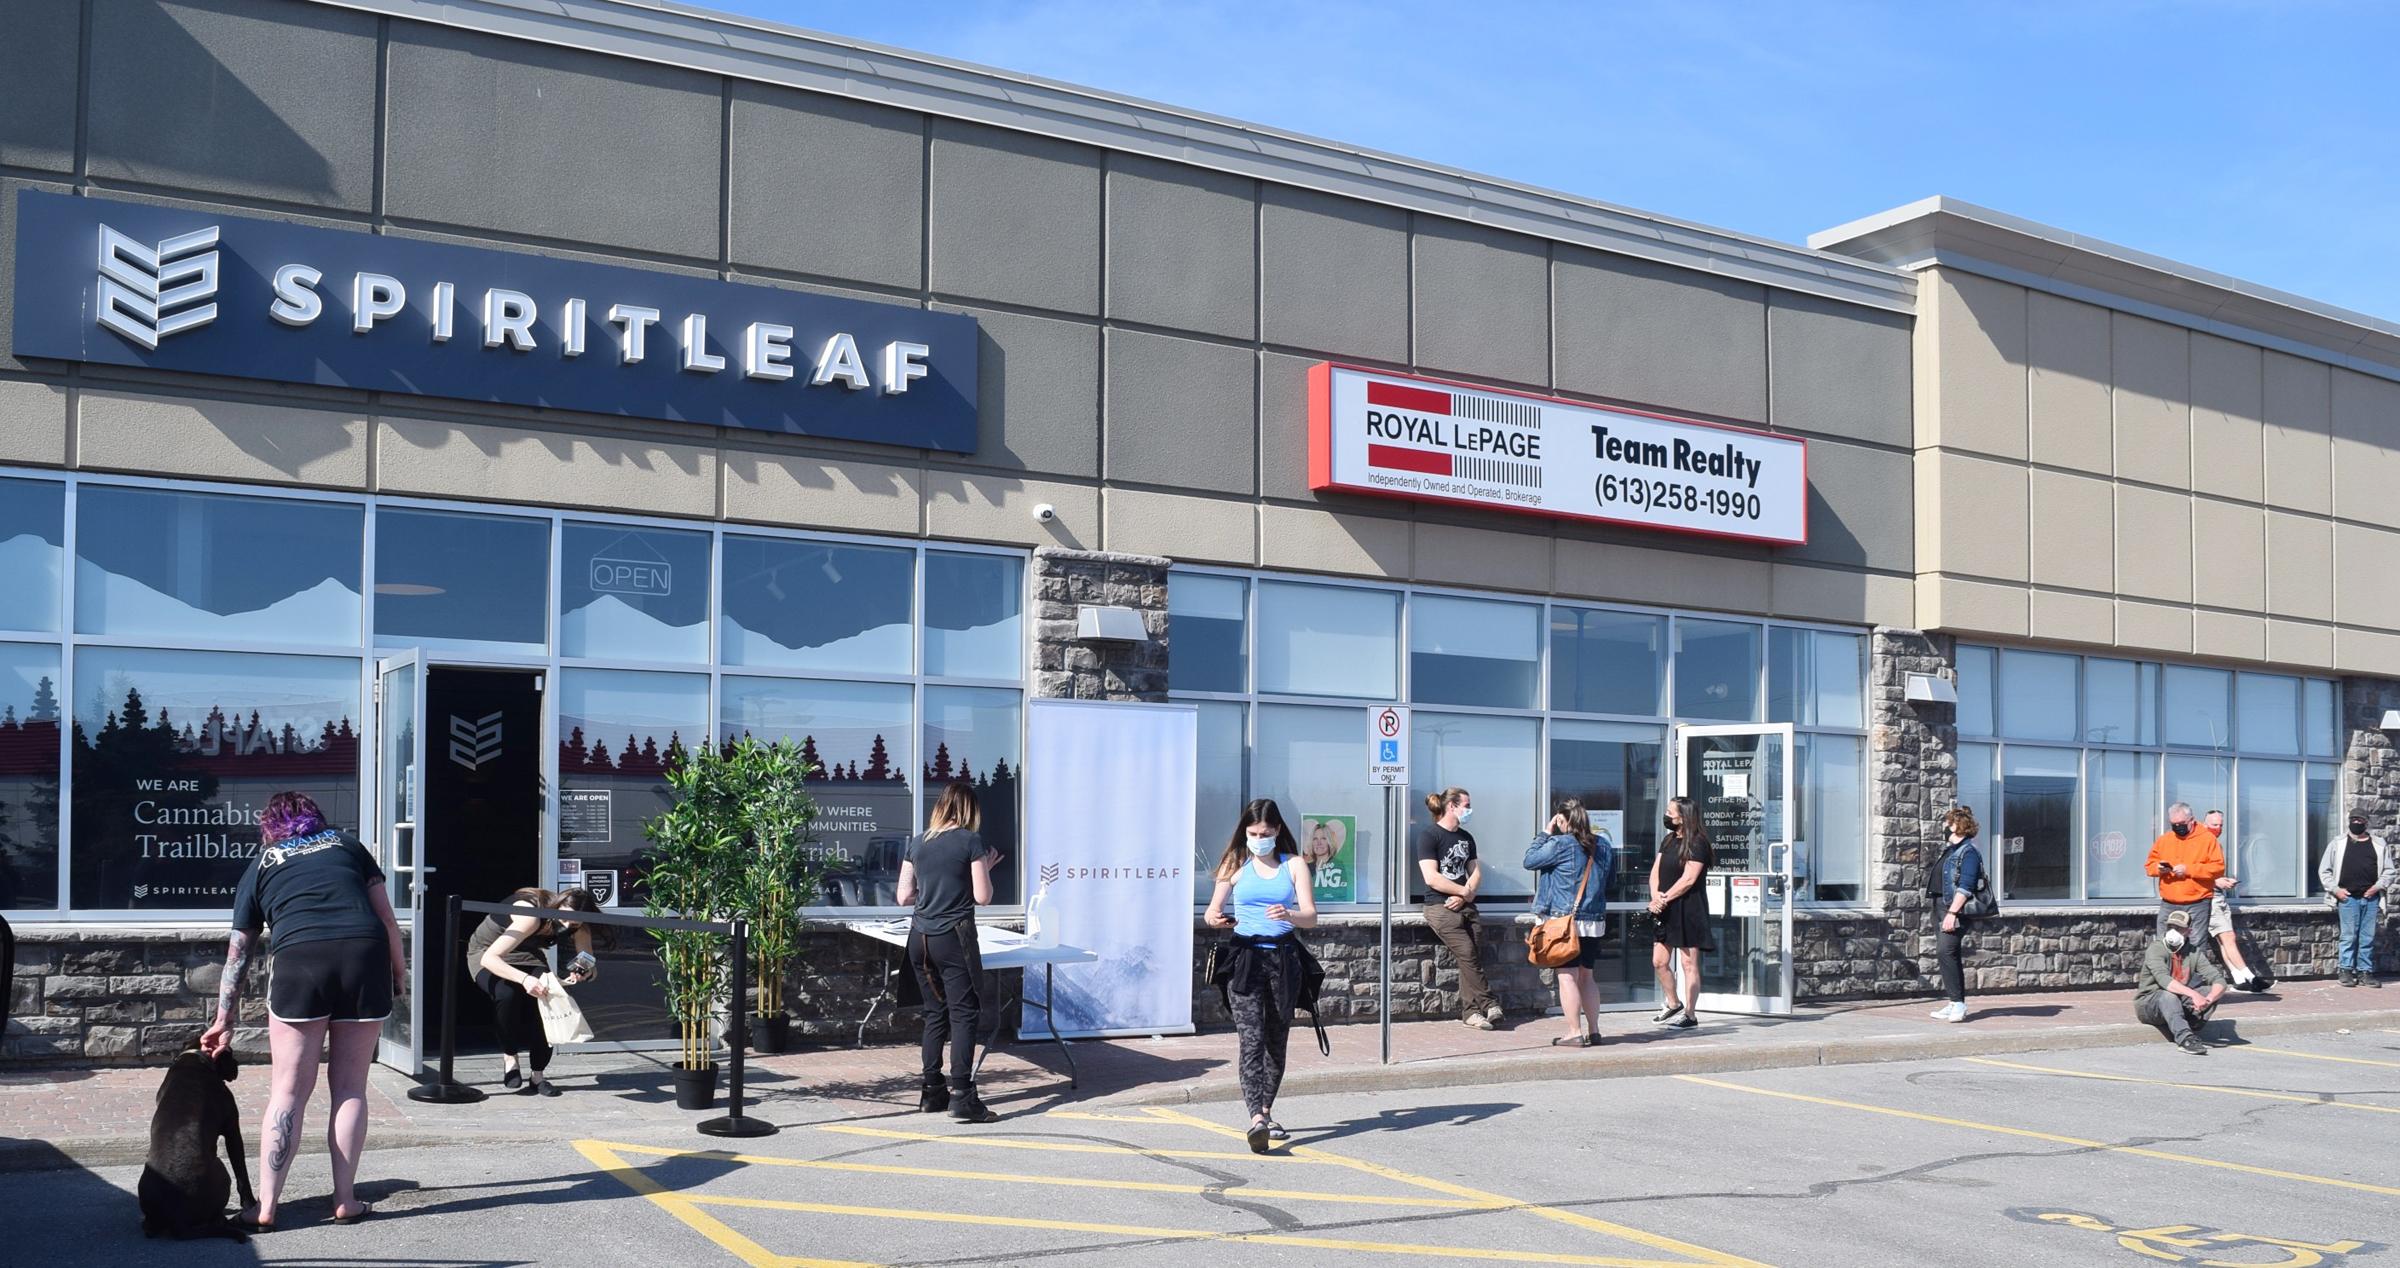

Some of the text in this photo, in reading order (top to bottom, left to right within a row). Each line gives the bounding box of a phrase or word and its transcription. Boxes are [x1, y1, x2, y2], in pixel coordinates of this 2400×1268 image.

[269, 263, 930, 395] SPIRITLEAF
[1367, 410, 1448, 447] ROYAL
[1591, 425, 1761, 489] Team Realty
[1368, 472, 1542, 506] Independently Owned and Operated, Brokerage
[1595, 473, 1761, 521] (613)258-1990
[594, 564, 668, 589] OPEN
[1703, 759, 1732, 769] ROYAL
[136, 779, 200, 792] WE ARE
[134, 800, 263, 826] Cannabis
[827, 806, 873, 817] WHERE
[802, 822, 877, 832] MMUNITIES
[1317, 860, 1335, 870] Love
[1720, 858, 1750, 866] SUNDAY
[1066, 867, 1180, 879] SPIRITLEAF
[153, 887, 237, 895] SPIRITLEAF
